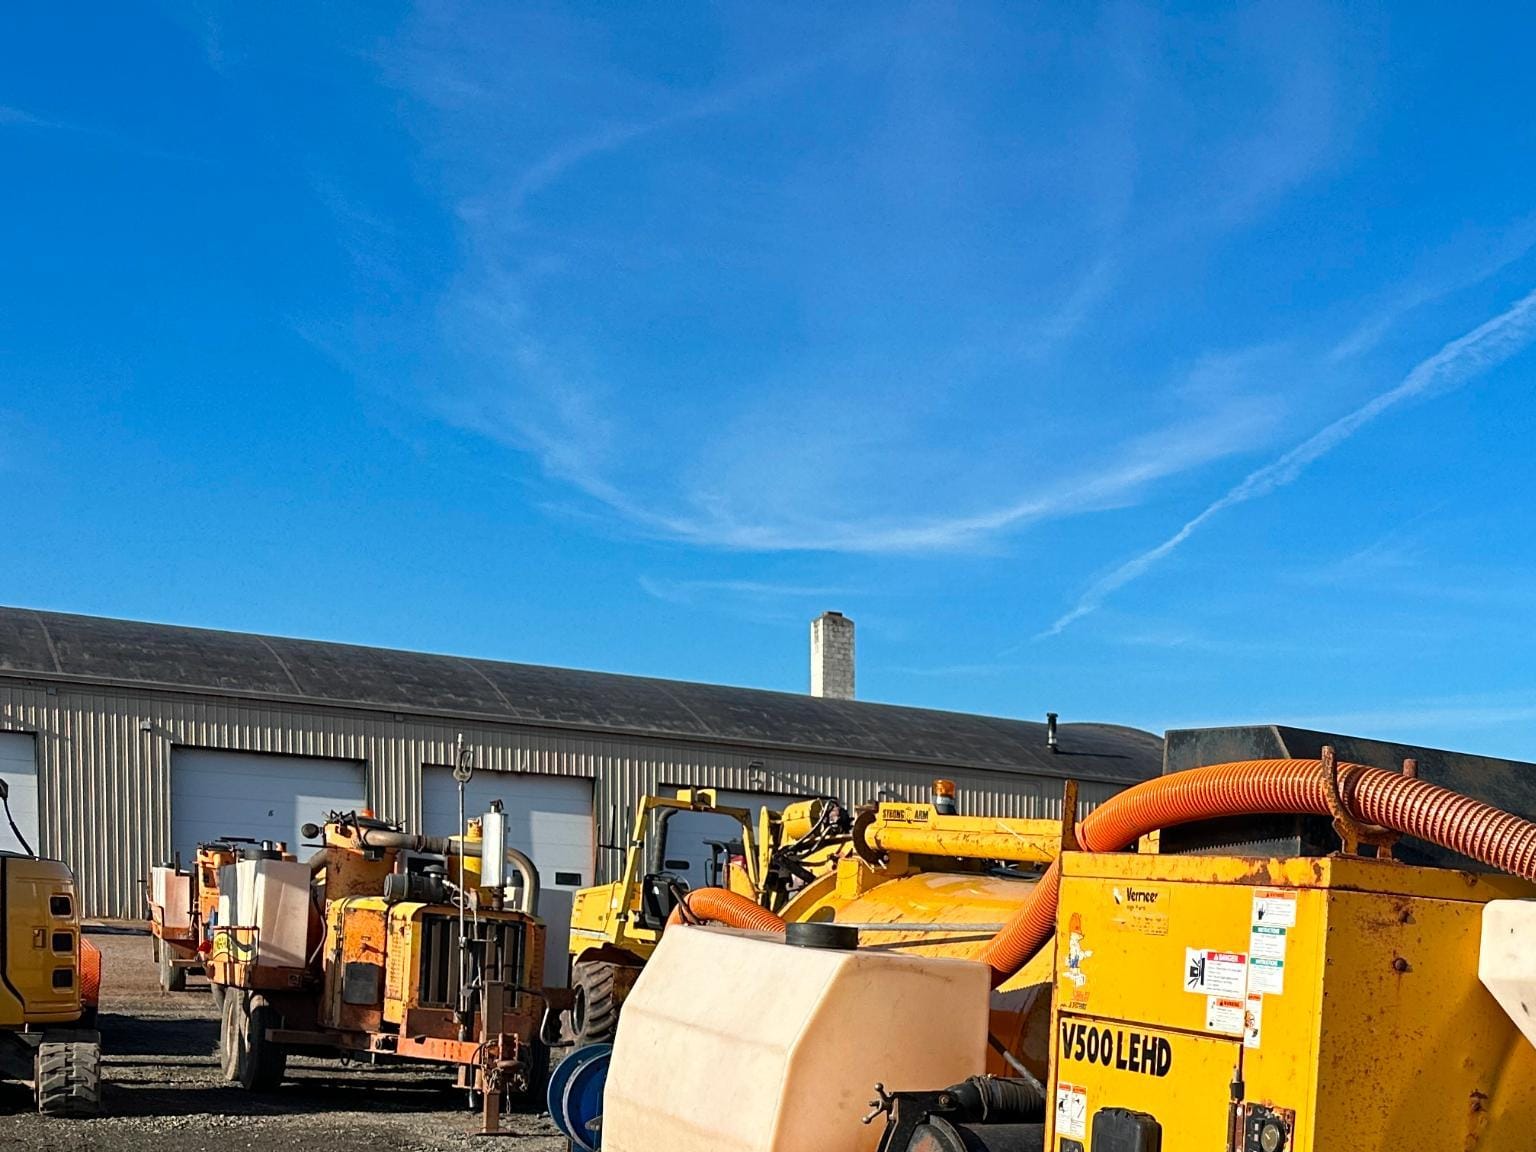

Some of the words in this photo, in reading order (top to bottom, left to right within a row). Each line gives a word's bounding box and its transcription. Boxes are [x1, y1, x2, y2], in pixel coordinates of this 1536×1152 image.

[883, 809, 905, 819] STRONG
[914, 810, 929, 820] ARM
[1126, 887, 1158, 903] Vermeer
[1062, 1021, 1113, 1067] V500
[1116, 1030, 1172, 1077] LEHD
